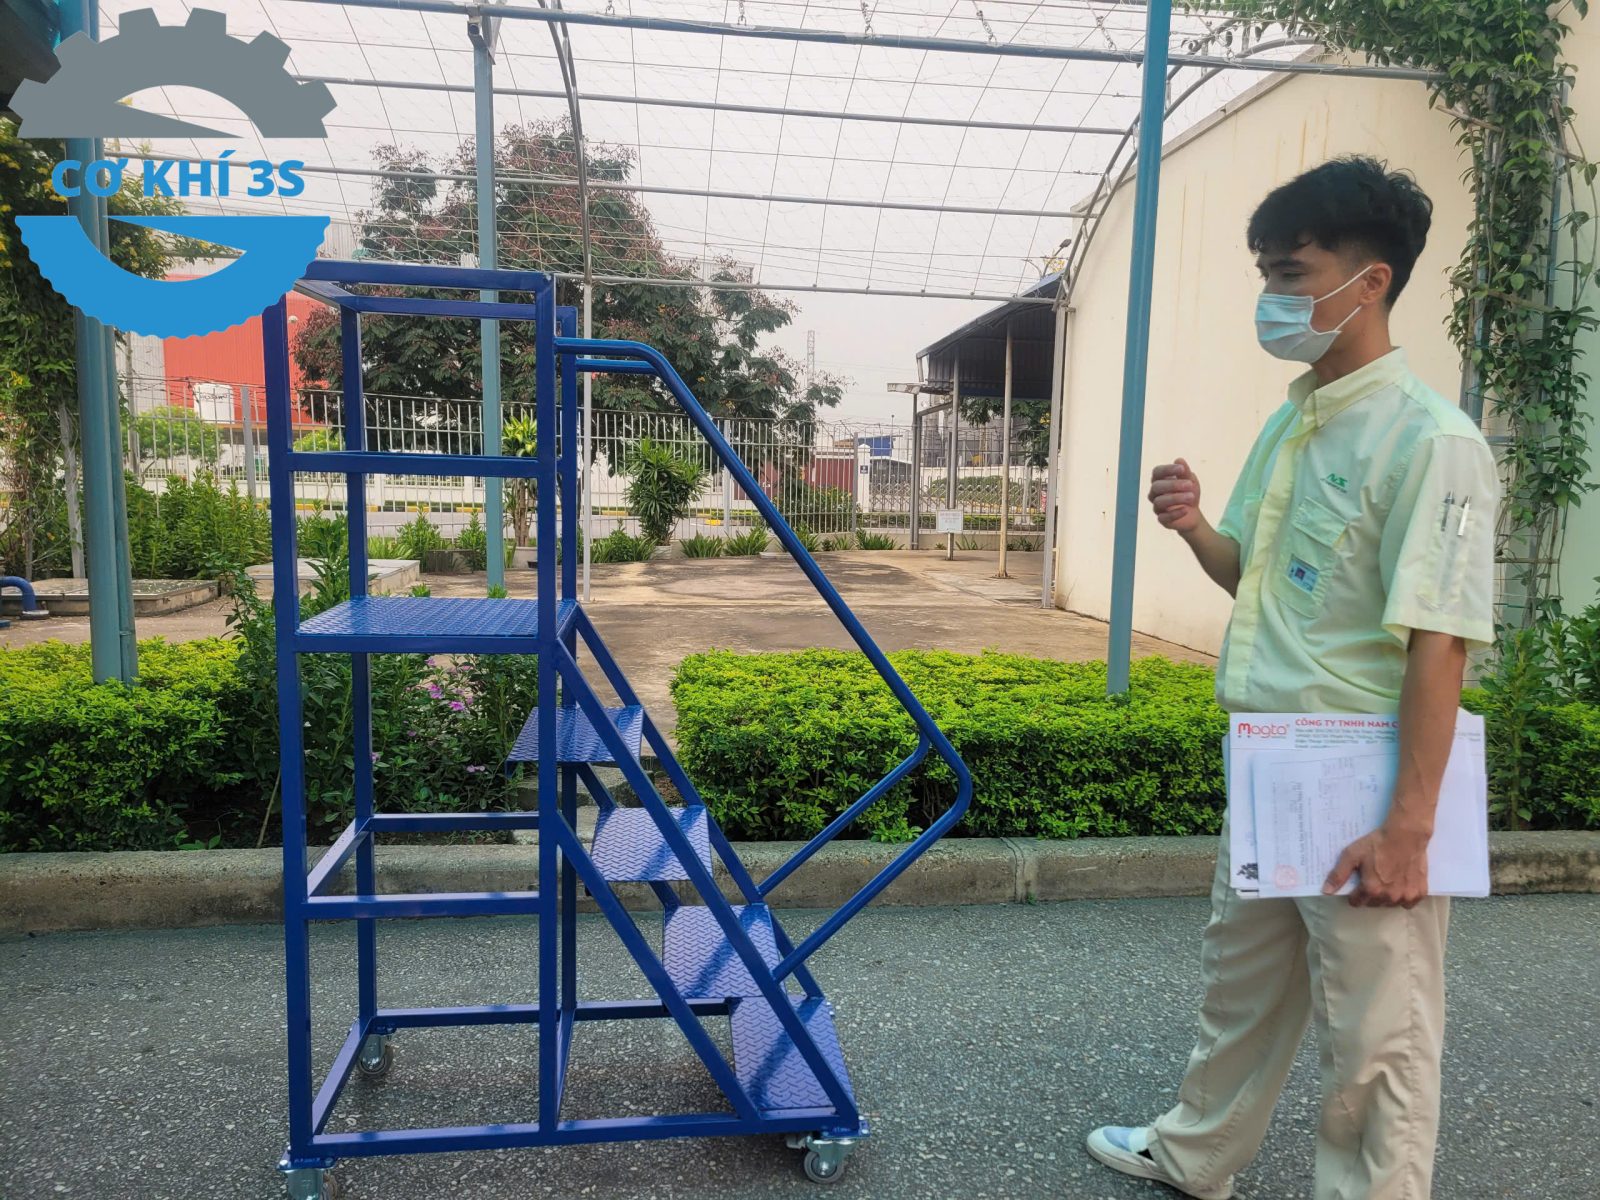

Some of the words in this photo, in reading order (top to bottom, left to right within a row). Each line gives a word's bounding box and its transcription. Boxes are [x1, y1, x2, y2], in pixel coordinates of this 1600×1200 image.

[1295, 717, 1322, 727] CÔNG
[1325, 719, 1336, 727] TY
[1339, 719, 1365, 727] TNHH
[1368, 720, 1389, 728] NAM
